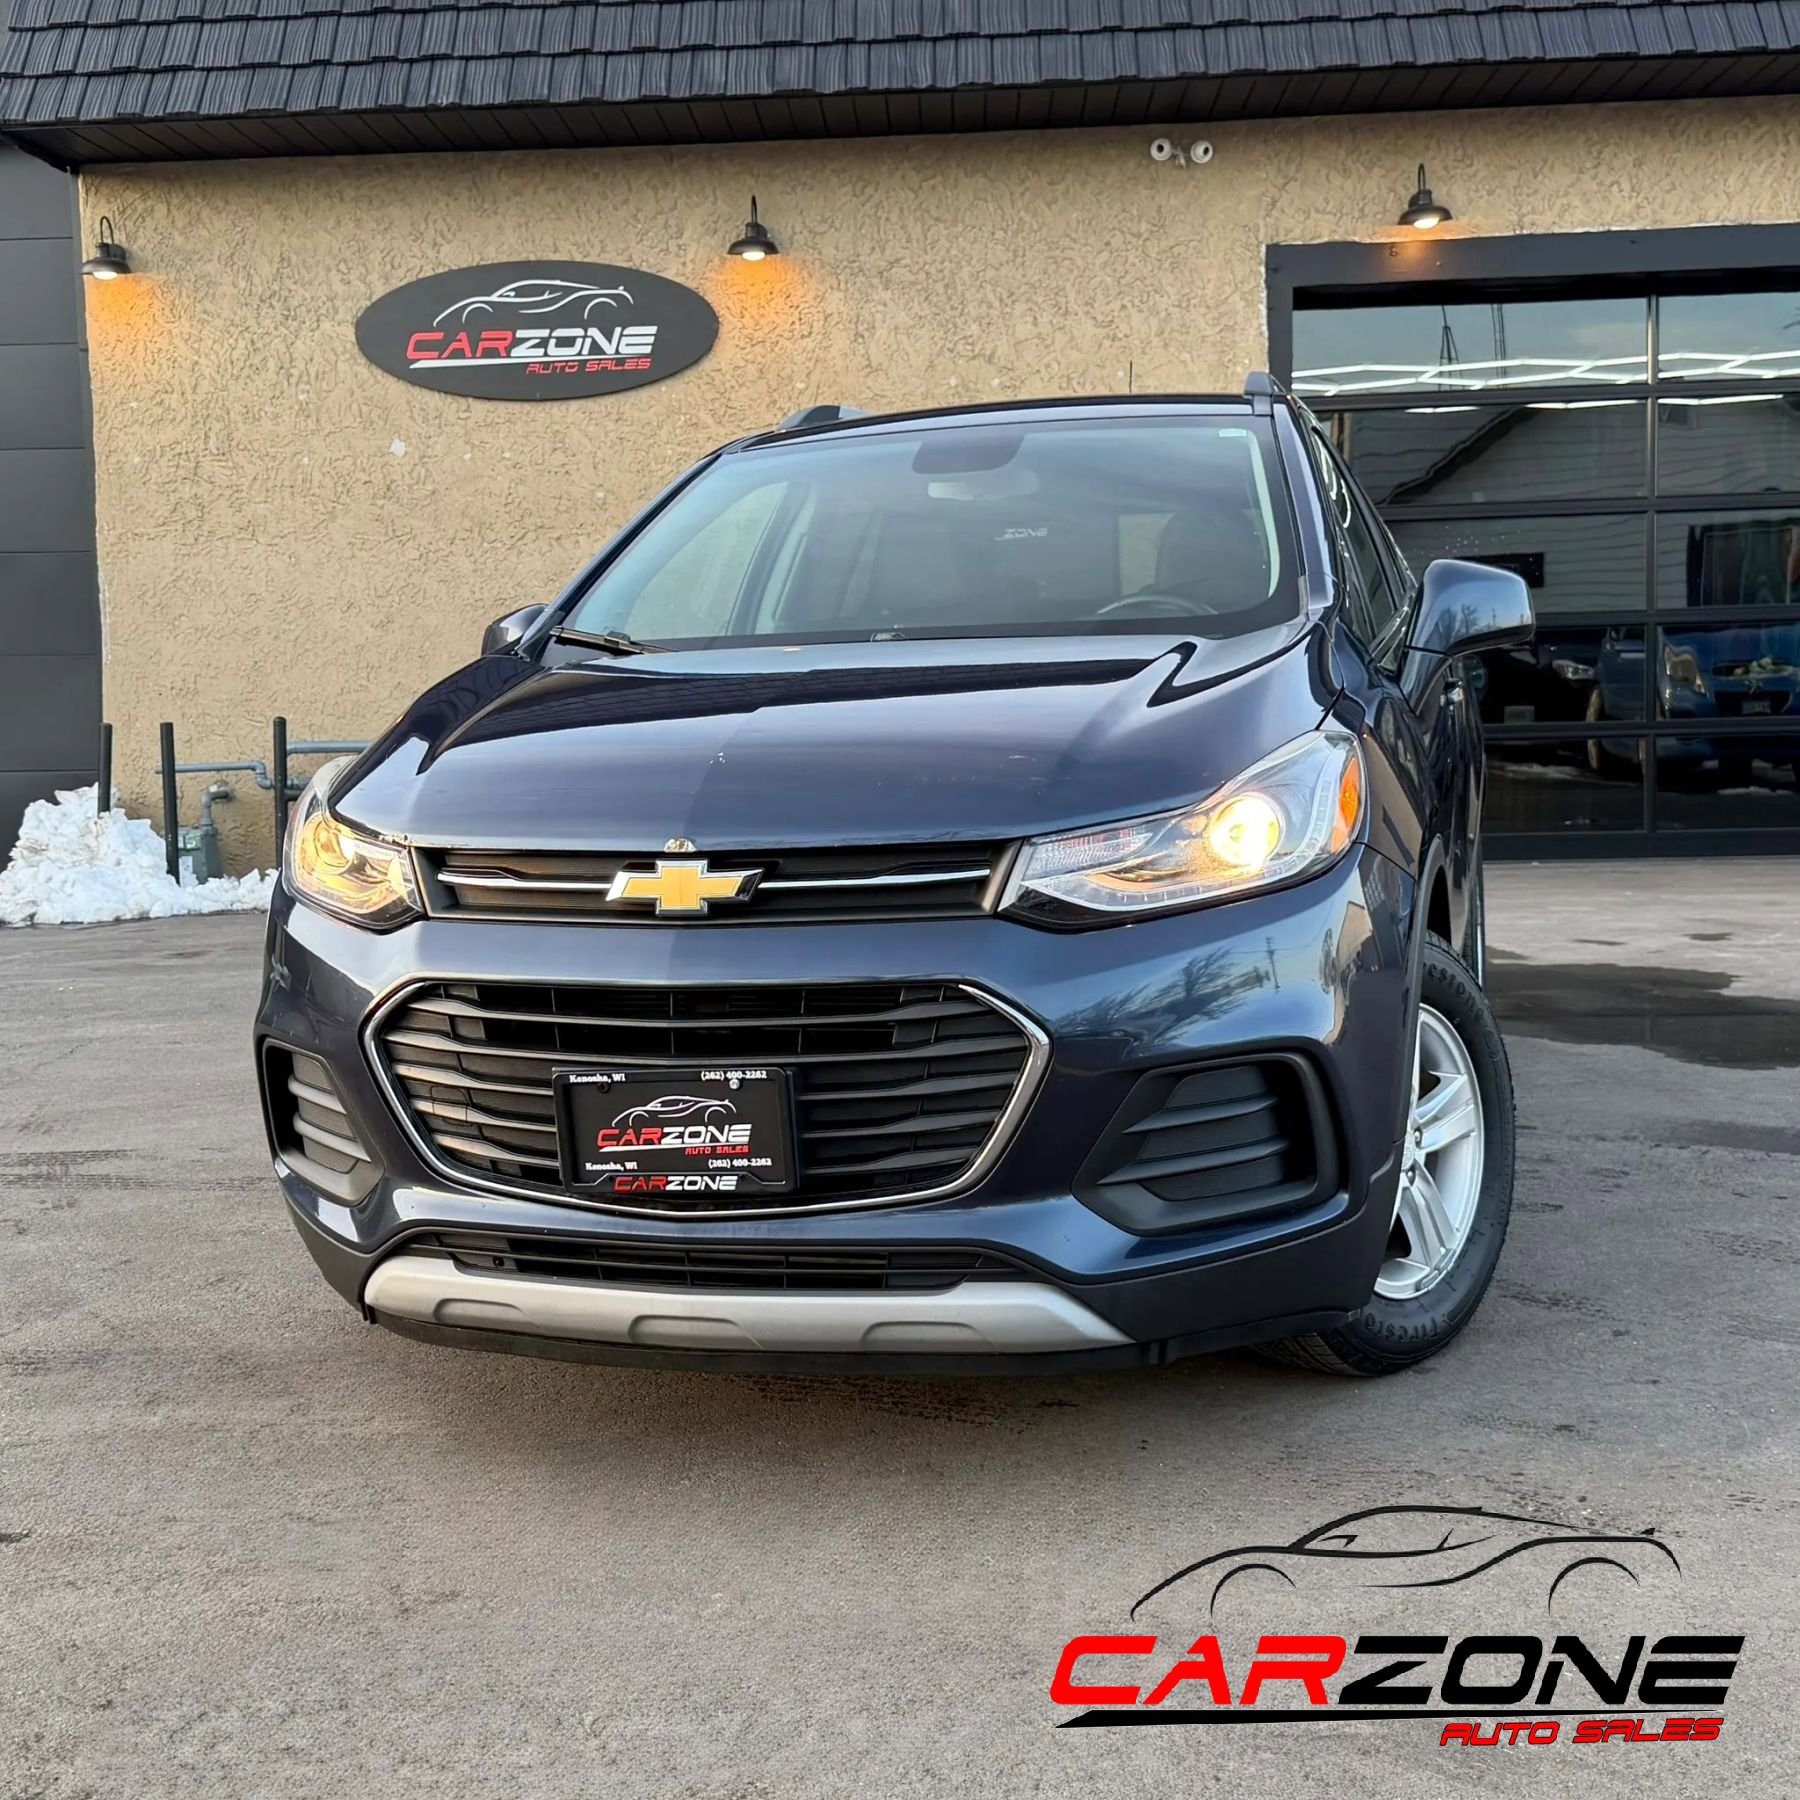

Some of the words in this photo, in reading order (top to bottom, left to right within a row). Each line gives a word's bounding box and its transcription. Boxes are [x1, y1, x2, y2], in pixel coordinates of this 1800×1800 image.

[406, 325, 658, 361] CARZONE
[526, 361, 579, 375] AUTO
[585, 357, 652, 372] SALES
[612, 1073, 626, 1082] WI
[597, 1124, 752, 1147] CARZONE
[685, 1146, 712, 1155] AUTO
[716, 1145, 749, 1154] SALES
[624, 1161, 638, 1170] WI
[615, 1176, 738, 1192] CARZONE
